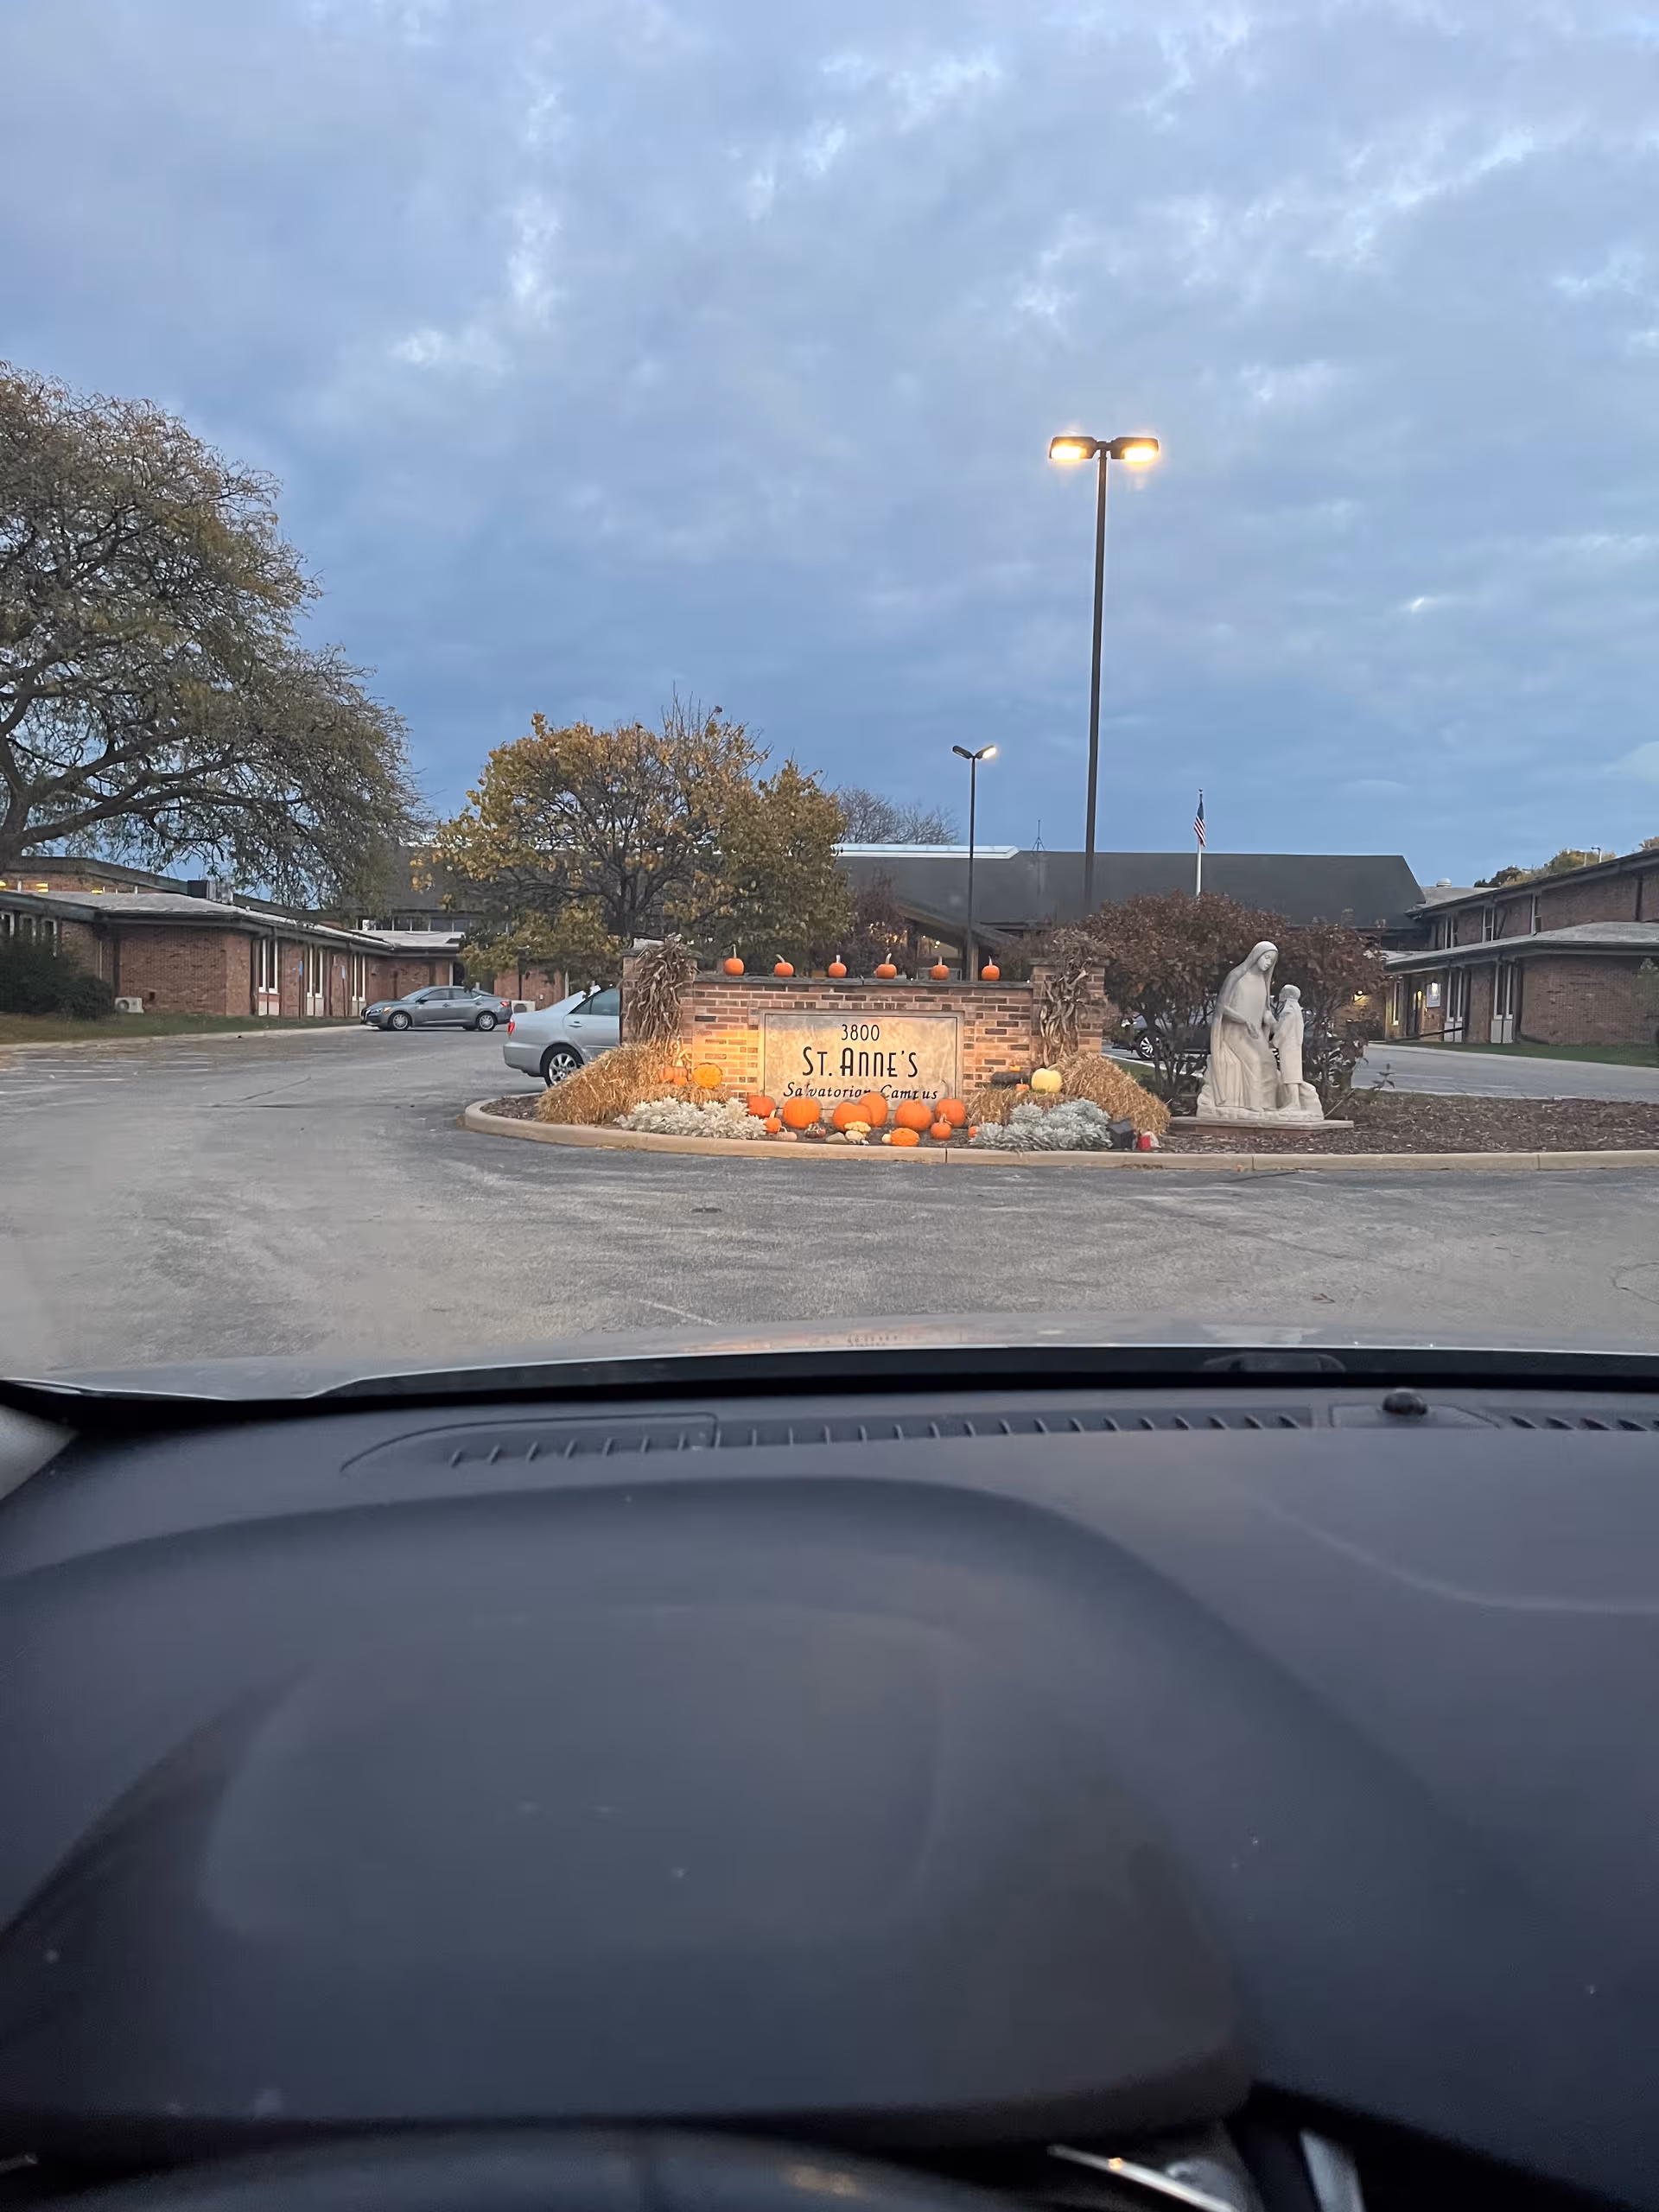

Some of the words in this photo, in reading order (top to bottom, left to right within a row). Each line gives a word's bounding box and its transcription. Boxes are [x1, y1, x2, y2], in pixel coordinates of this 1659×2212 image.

[841, 1024, 880, 1041] 3800
[802, 1046, 833, 1077] ST.
[839, 1046, 918, 1077] ANNE'S
